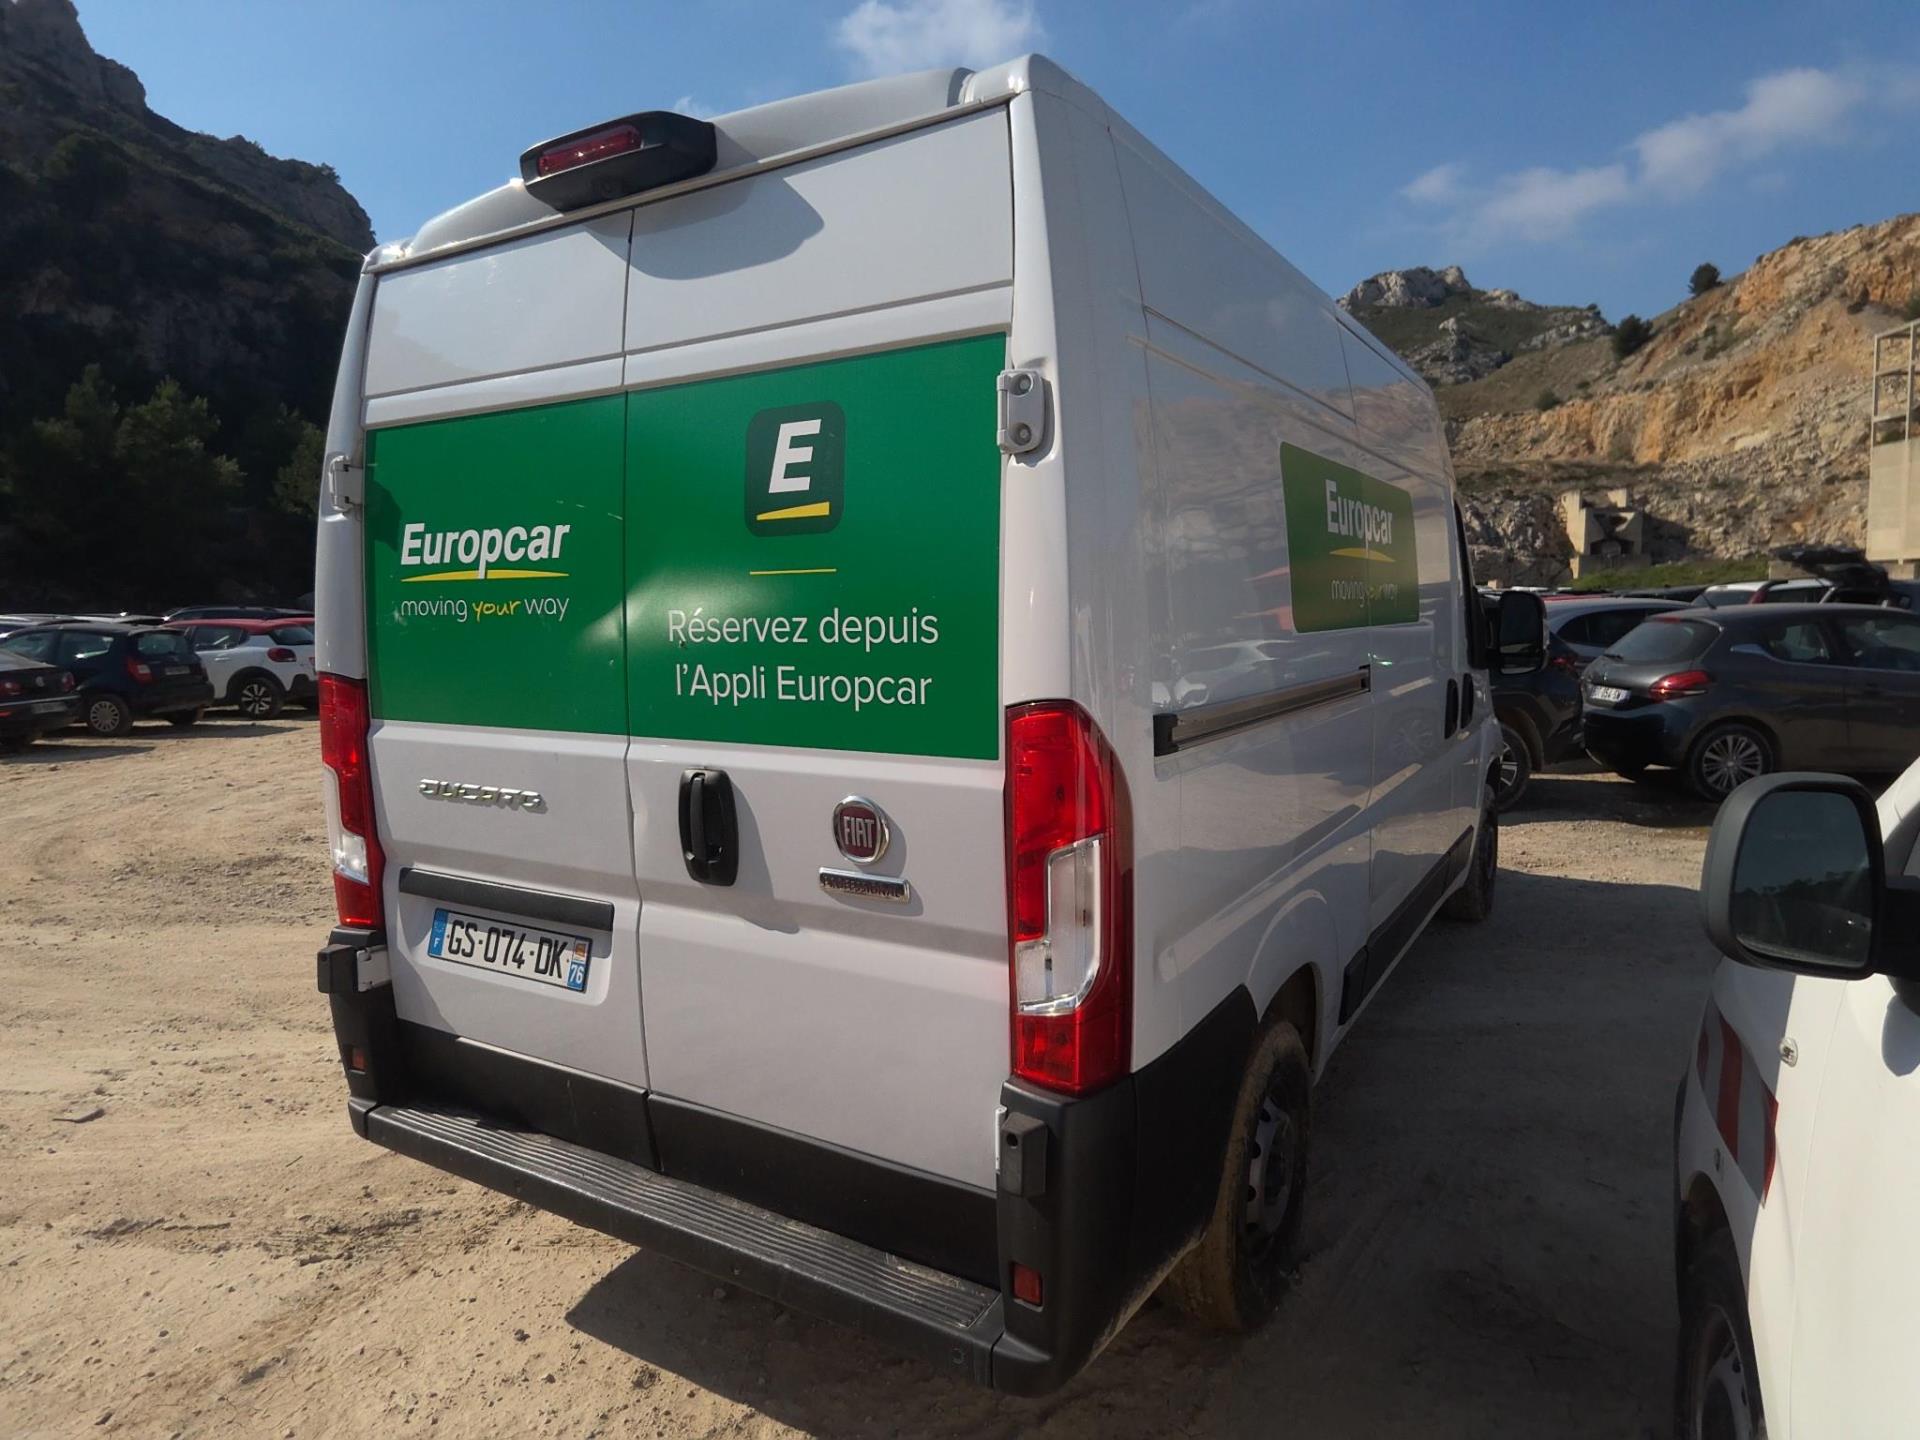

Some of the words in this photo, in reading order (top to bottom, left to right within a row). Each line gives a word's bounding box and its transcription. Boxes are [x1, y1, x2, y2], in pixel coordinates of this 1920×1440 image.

[768, 418, 822, 494] E
[1325, 478, 1393, 558] Europcar
[400, 522, 571, 580] Europcar
[401, 596, 467, 623] moving
[473, 600, 520, 623] your
[524, 597, 570, 622] way
[667, 607, 809, 643] Réservez
[818, 607, 940, 653] depuis
[675, 663, 766, 707] l'Appli
[777, 665, 933, 712] Europcar
[843, 815, 875, 849] FIAT
[433, 938, 440, 948] F
[569, 965, 585, 984] 76
